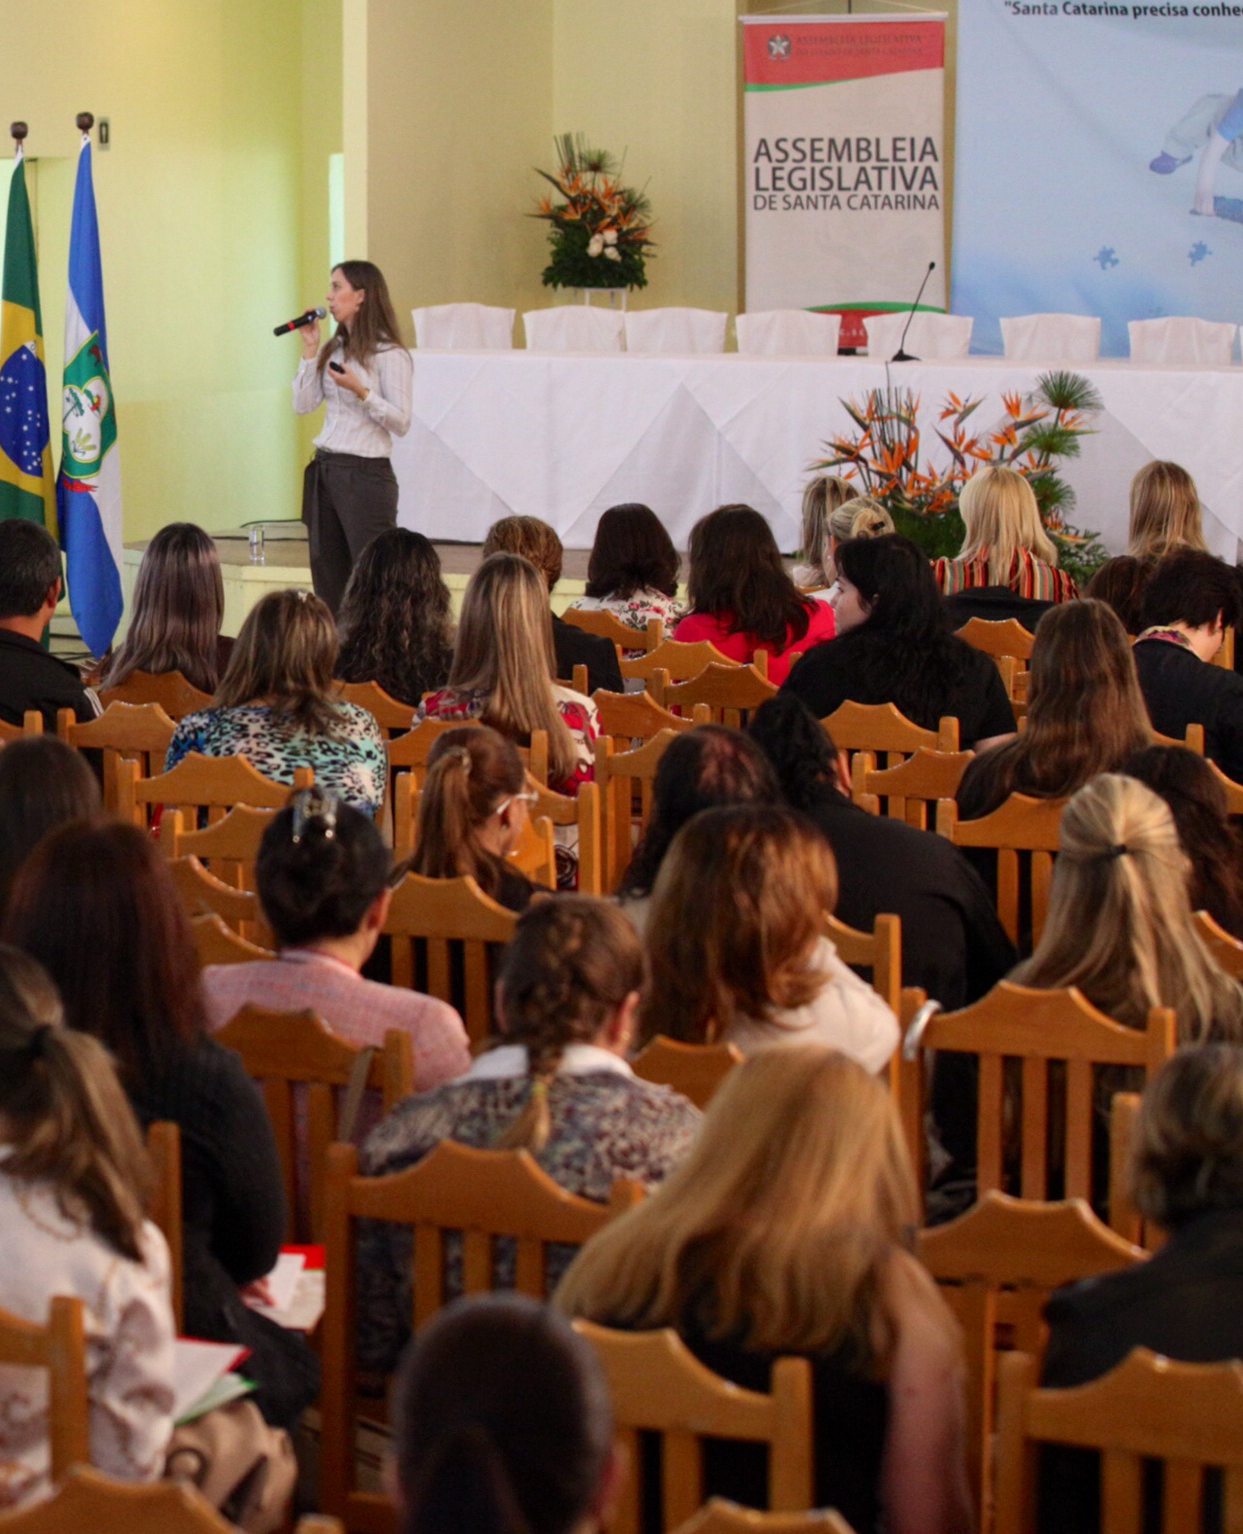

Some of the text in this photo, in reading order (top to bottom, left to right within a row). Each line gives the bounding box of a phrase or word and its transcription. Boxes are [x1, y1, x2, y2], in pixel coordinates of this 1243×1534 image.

[1062, 1, 1129, 16] Catarina
[1132, 2, 1188, 20] precisa
[1192, 2, 1243, 17] conhe
[753, 137, 939, 163] ASSEMBLEIA
[755, 166, 939, 192] LEGISLATIVA
[753, 194, 939, 210] DE SANTA CATARINA
